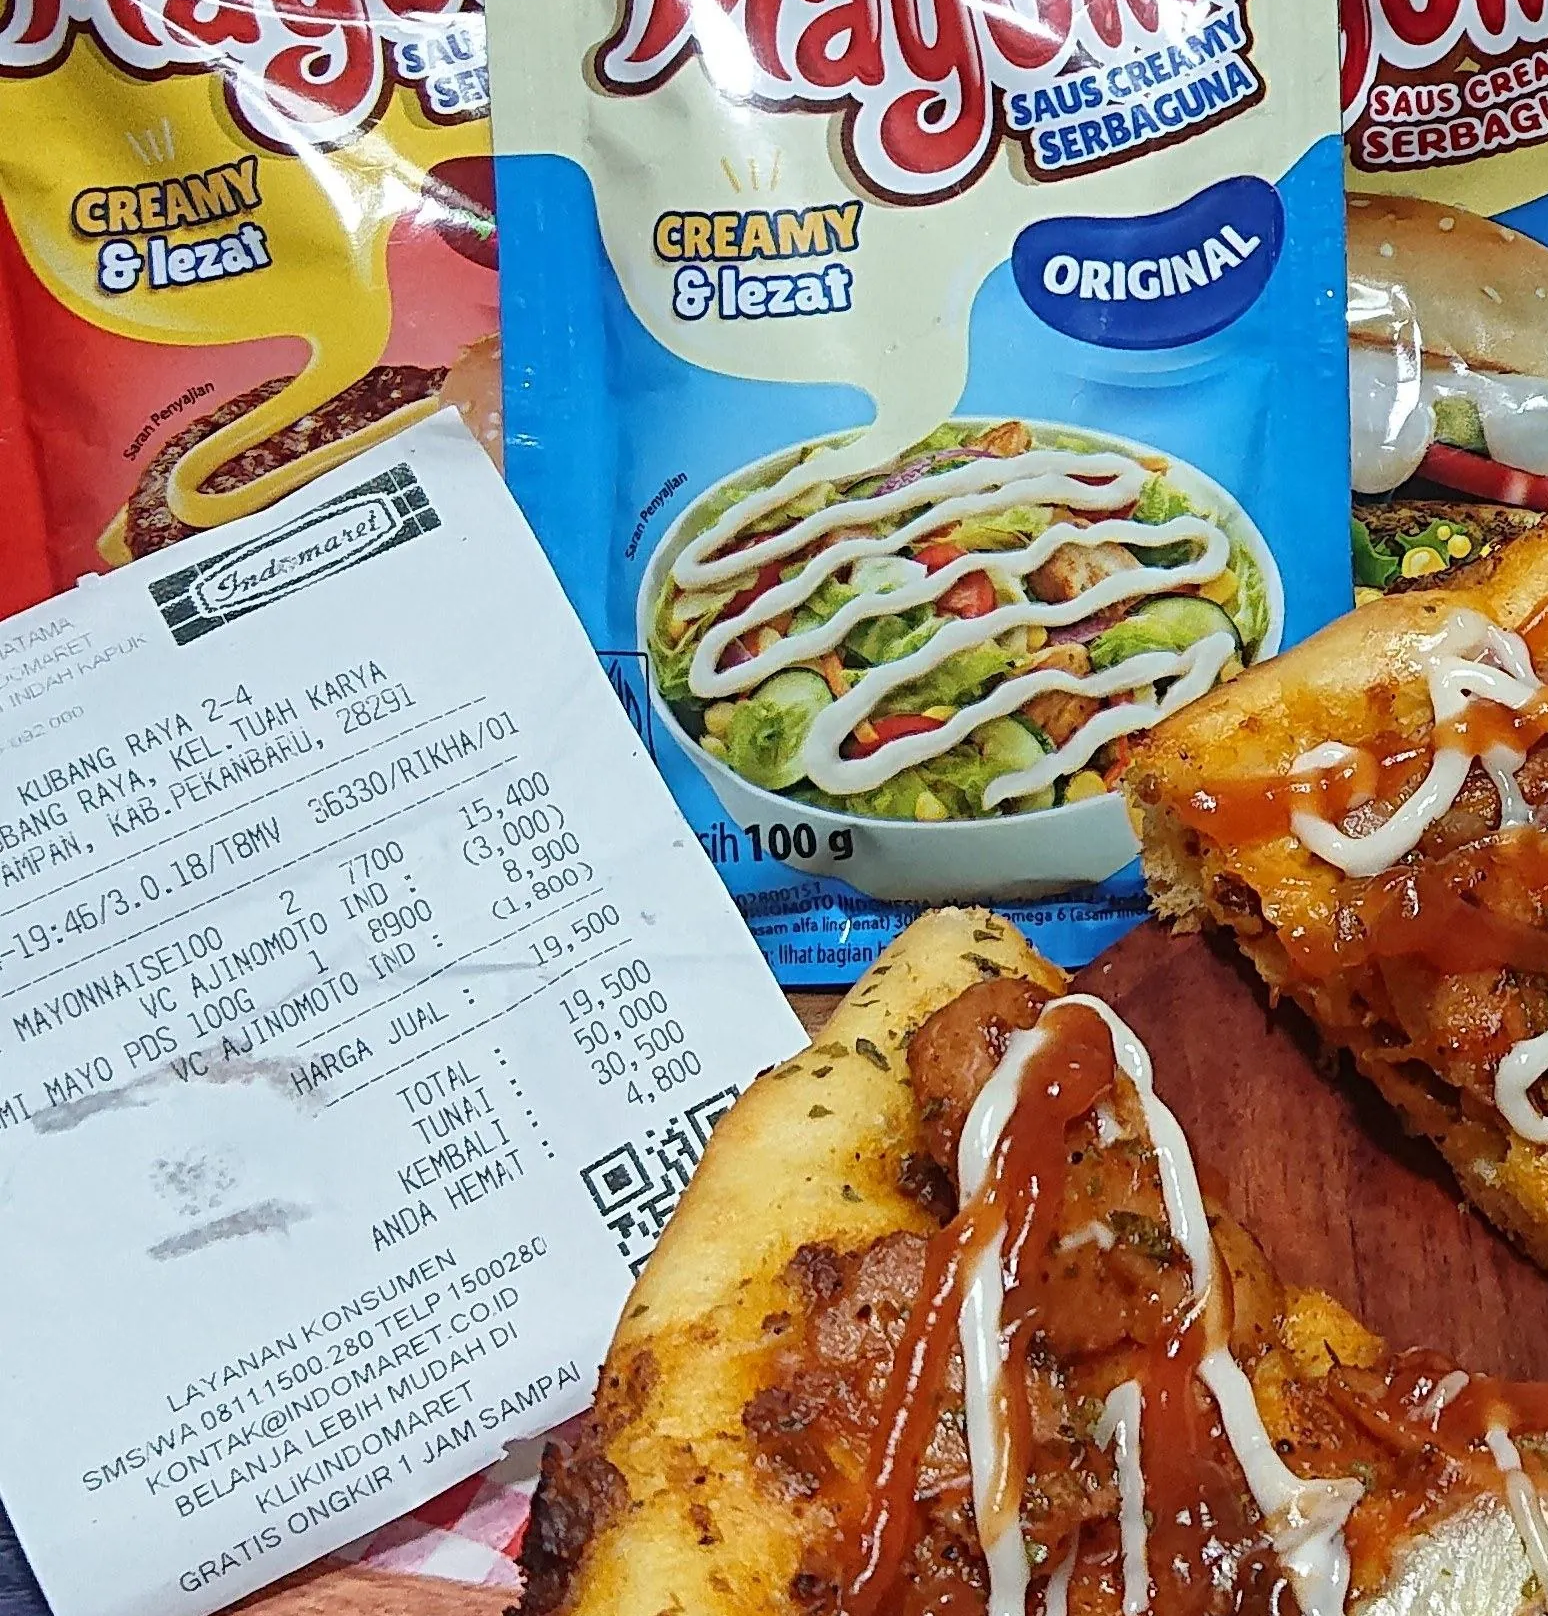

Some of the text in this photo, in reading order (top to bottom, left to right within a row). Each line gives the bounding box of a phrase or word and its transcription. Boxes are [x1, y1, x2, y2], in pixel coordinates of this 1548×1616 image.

[1011, 11, 1242, 126] SAUS CREAMY
[1038, 61, 1253, 165] SERBAGUNA
[1372, 88, 1454, 117] SAUS
[73, 157, 260, 235] CREAMY
[99, 223, 272, 292] & lezat
[655, 201, 862, 261] CREAMY
[674, 263, 853, 319] & lezat
[1041, 221, 1262, 303] ORIGINAL
[123, 381, 215, 461] Saran Penyajian
[624, 470, 689, 562] Saran Penyajian
[17, 684, 253, 807] KUBANG RAYA 2-4
[76, 768, 157, 814] RAYA,
[169, 697, 299, 772] KEL.TUAH
[305, 660, 388, 711] KARYA
[307, 710, 519, 824] 36330/RIKHA/01
[335, 682, 417, 735] 28291
[744, 823, 818, 863] 100
[827, 827, 855, 862] g
[12, 770, 550, 1042] MAYONNAISE100 2 7700 15,400
[139, 986, 177, 1019] VC
[191, 912, 328, 999] AJINOMOTO
[339, 882, 389, 921] IND
[463, 803, 565, 867] (3,000)
[778, 942, 814, 965] lihat
[816, 942, 874, 969] bagian
[792, 916, 818, 934] alfa
[1056, 906, 1067, 923] 6
[43, 1055, 113, 1107] MAYO
[123, 1025, 178, 1068] PDS
[187, 987, 255, 1038] 100G
[307, 949, 329, 975] 1
[368, 898, 433, 944] 8900
[502, 831, 580, 883] 8,900
[170, 1050, 209, 1082] VC
[222, 971, 359, 1062] AJINOMOTO
[369, 942, 416, 980] IND
[492, 861, 594, 920] (1,800)
[290, 1037, 374, 1096] HARGA
[388, 1001, 450, 1045] JUAL
[528, 903, 621, 968] 19,500
[396, 1060, 481, 1113] TOTAL
[558, 958, 652, 1025] 19,500
[411, 1086, 495, 1145] TUNAI
[573, 990, 669, 1055] 50,000
[372, 1199, 438, 1253] ANDA
[443, 1148, 525, 1211] HEMAT
[626, 1050, 702, 1106] 4,800
[397, 1118, 511, 1195] KEMBALI
[591, 1019, 686, 1086] 30,500
[82, 1235, 548, 1492] SMS/WA 08111500.280 TELP 1500280
[145, 1286, 520, 1496] KONTAK@INDOMARET.CO.ID
[167, 1248, 458, 1414] LAYANAN KONSUMEN
[174, 1320, 519, 1518] BELANJA LEBIH MUDAH DI
[179, 1360, 582, 1593] GRATIS ONGKIR 1 JAM SAMPAI
